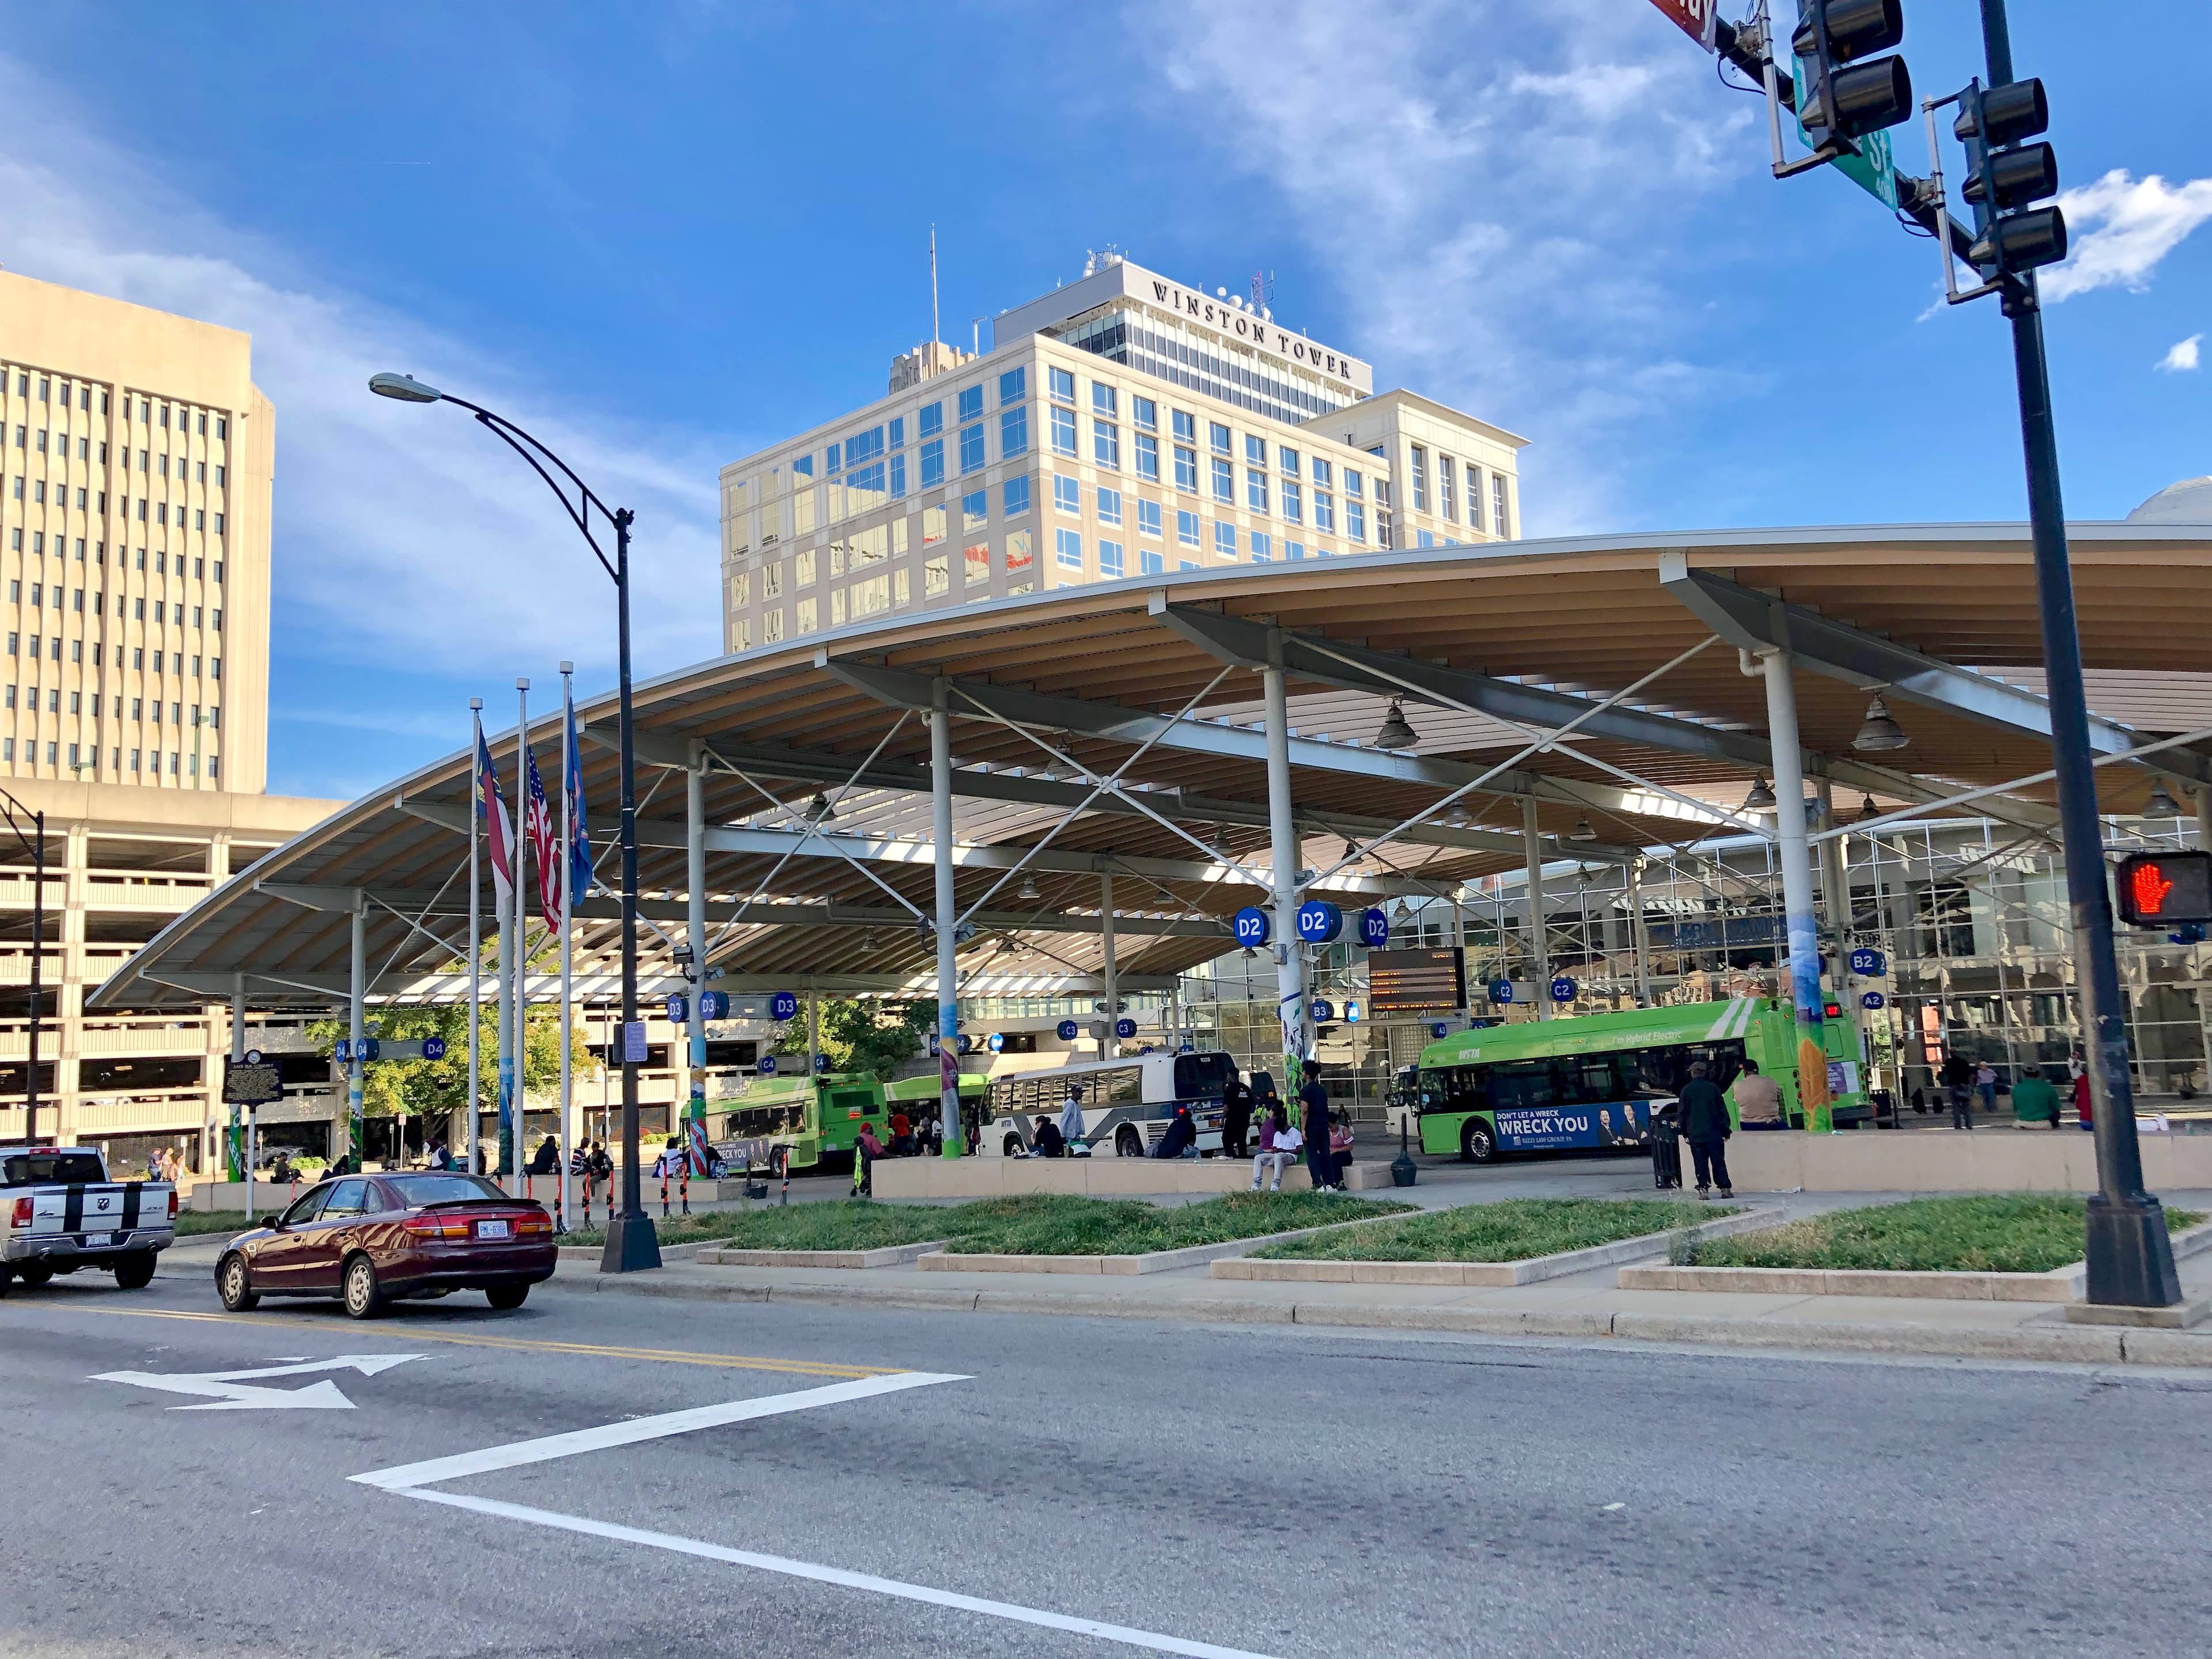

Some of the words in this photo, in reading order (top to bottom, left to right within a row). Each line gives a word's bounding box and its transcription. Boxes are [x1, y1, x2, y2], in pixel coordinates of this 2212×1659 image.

[1153, 281, 1264, 344] WINSTON
[1278, 334, 1351, 380] TOWER
[1301, 911, 1325, 931] D2
[1238, 918, 1260, 937] D2
[1369, 919, 1385, 937] D2
[1854, 955, 1873, 968] B2
[1501, 986, 1511, 997] C2
[1554, 984, 1570, 996] C2
[702, 999, 714, 1013] D3
[778, 999, 793, 1013] D3
[1865, 996, 1880, 1005] A2
[669, 1002, 681, 1016] D3
[1314, 1006, 1326, 1017] B3
[1066, 1026, 1075, 1035] C3
[1119, 1024, 1128, 1033] C3
[1626, 1032, 1651, 1045] Hybrid
[1653, 1029, 1682, 1040] Electric
[337, 1046, 345, 1057] D4
[358, 1044, 367, 1056] D4
[428, 1044, 443, 1054] D4
[931, 1041, 940, 1050] B4
[1459, 1048, 1480, 1060] WSTA
[763, 1060, 774, 1068] C4
[816, 1058, 823, 1066] C4
[1535, 1109, 1559, 1118] WRECK
[1498, 1118, 1552, 1135] WRECK
[1554, 1116, 1588, 1132] YOU
[734, 1147, 747, 1158] YOU
